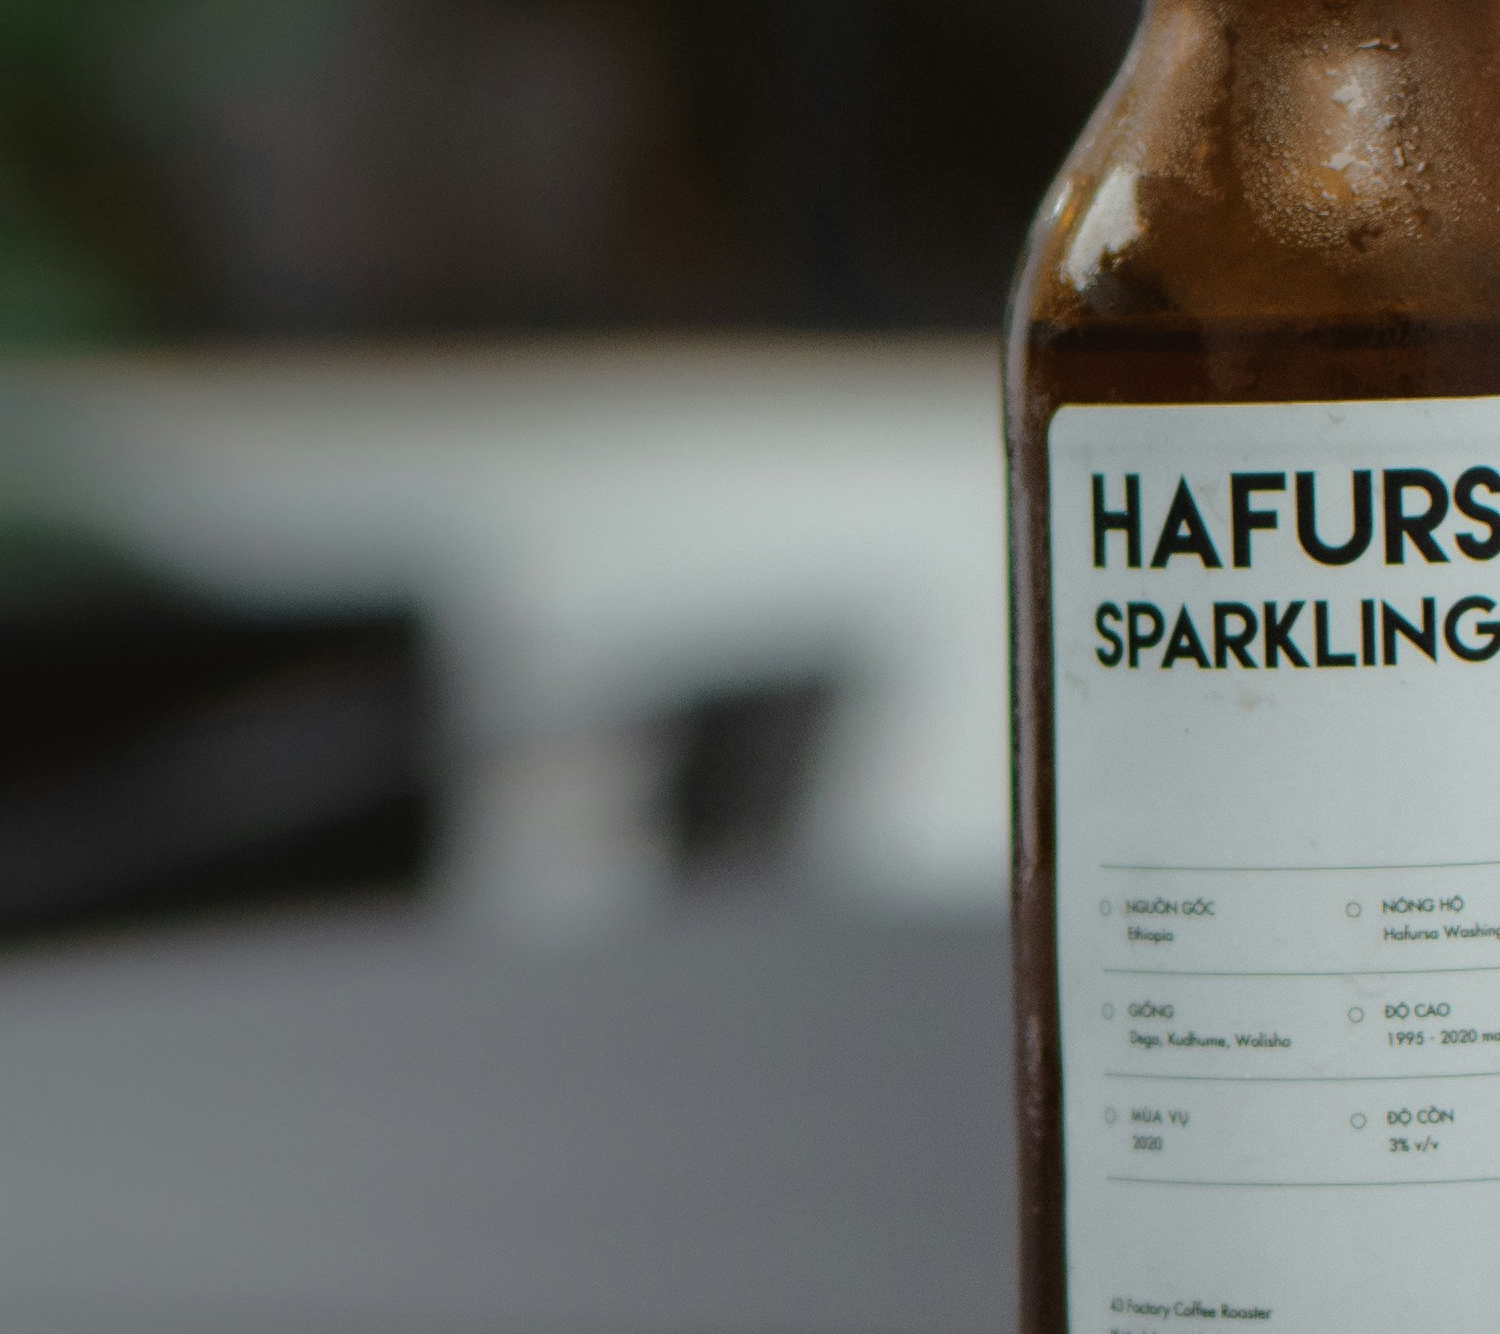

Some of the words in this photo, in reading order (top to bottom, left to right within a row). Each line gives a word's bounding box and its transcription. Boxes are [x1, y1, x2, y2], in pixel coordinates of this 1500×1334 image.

[1181, 898, 1215, 916] GỐC
[1381, 897, 1435, 914] NÔNG
[1439, 894, 1464, 914] HỘ
[1127, 927, 1174, 945] Ethiopia
[1383, 925, 1438, 941] Hafursa
[1128, 1000, 1174, 1018] GIỐNG
[1384, 1002, 1409, 1021] ĐỘ
[1414, 1003, 1451, 1019] CAO
[1235, 1031, 1291, 1048] Wolisho
[1387, 1029, 1424, 1046] 1995
[1440, 1029, 1478, 1044] 2020
[1168, 1109, 1189, 1126] VỤ
[1386, 1107, 1411, 1127] ĐỘ
[1416, 1105, 1454, 1124] CỒN
[1389, 1137, 1410, 1153] 3%
[1127, 1299, 1170, 1320] Factory
[1174, 1300, 1216, 1318] Coffee
[1221, 1303, 1272, 1320] Roaster
